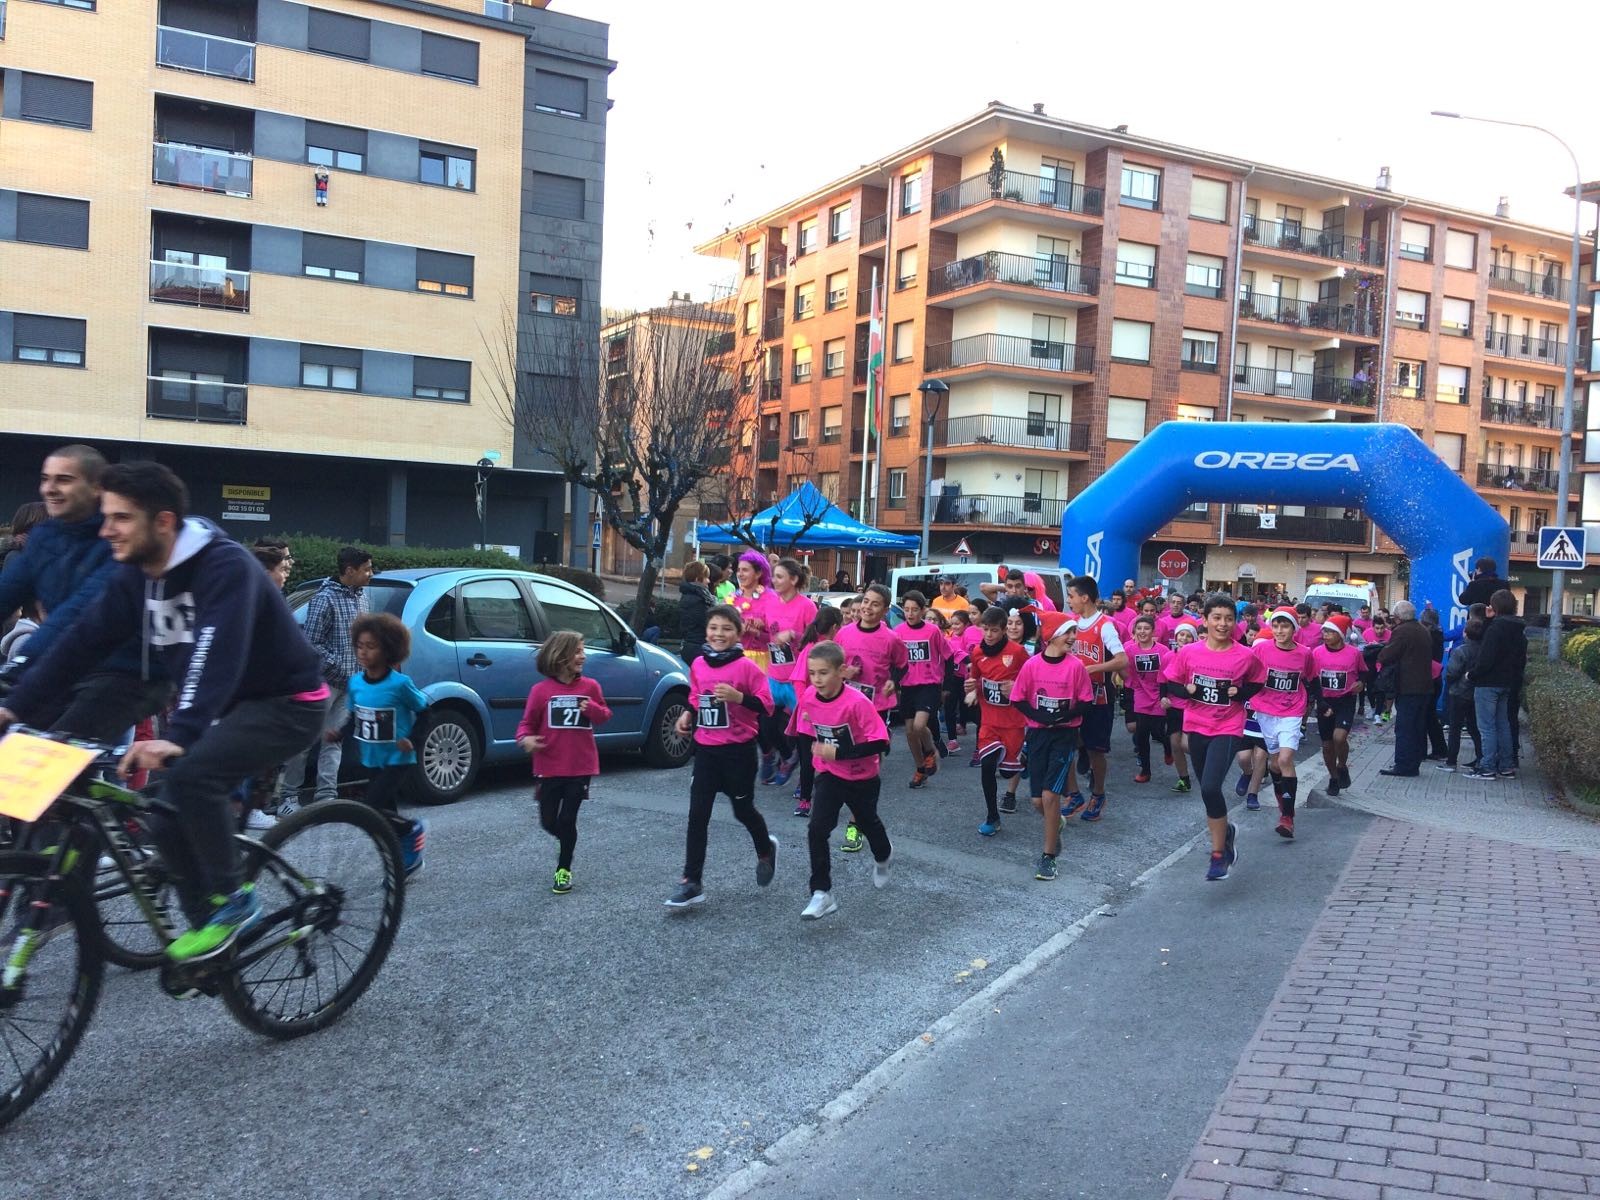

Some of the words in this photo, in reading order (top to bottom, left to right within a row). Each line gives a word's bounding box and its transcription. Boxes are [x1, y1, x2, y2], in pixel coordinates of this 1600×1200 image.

[1194, 450, 1361, 472] ORBEA
[909, 649, 925, 660] 130
[1142, 660, 1153, 671] 77
[1273, 678, 1293, 690] 100
[1328, 677, 1339, 689] 13
[988, 689, 1001, 703] 25
[1202, 686, 1219, 703] 35
[563, 708, 580, 726] 27
[701, 708, 719, 726] 107
[361, 720, 379, 740] 61
